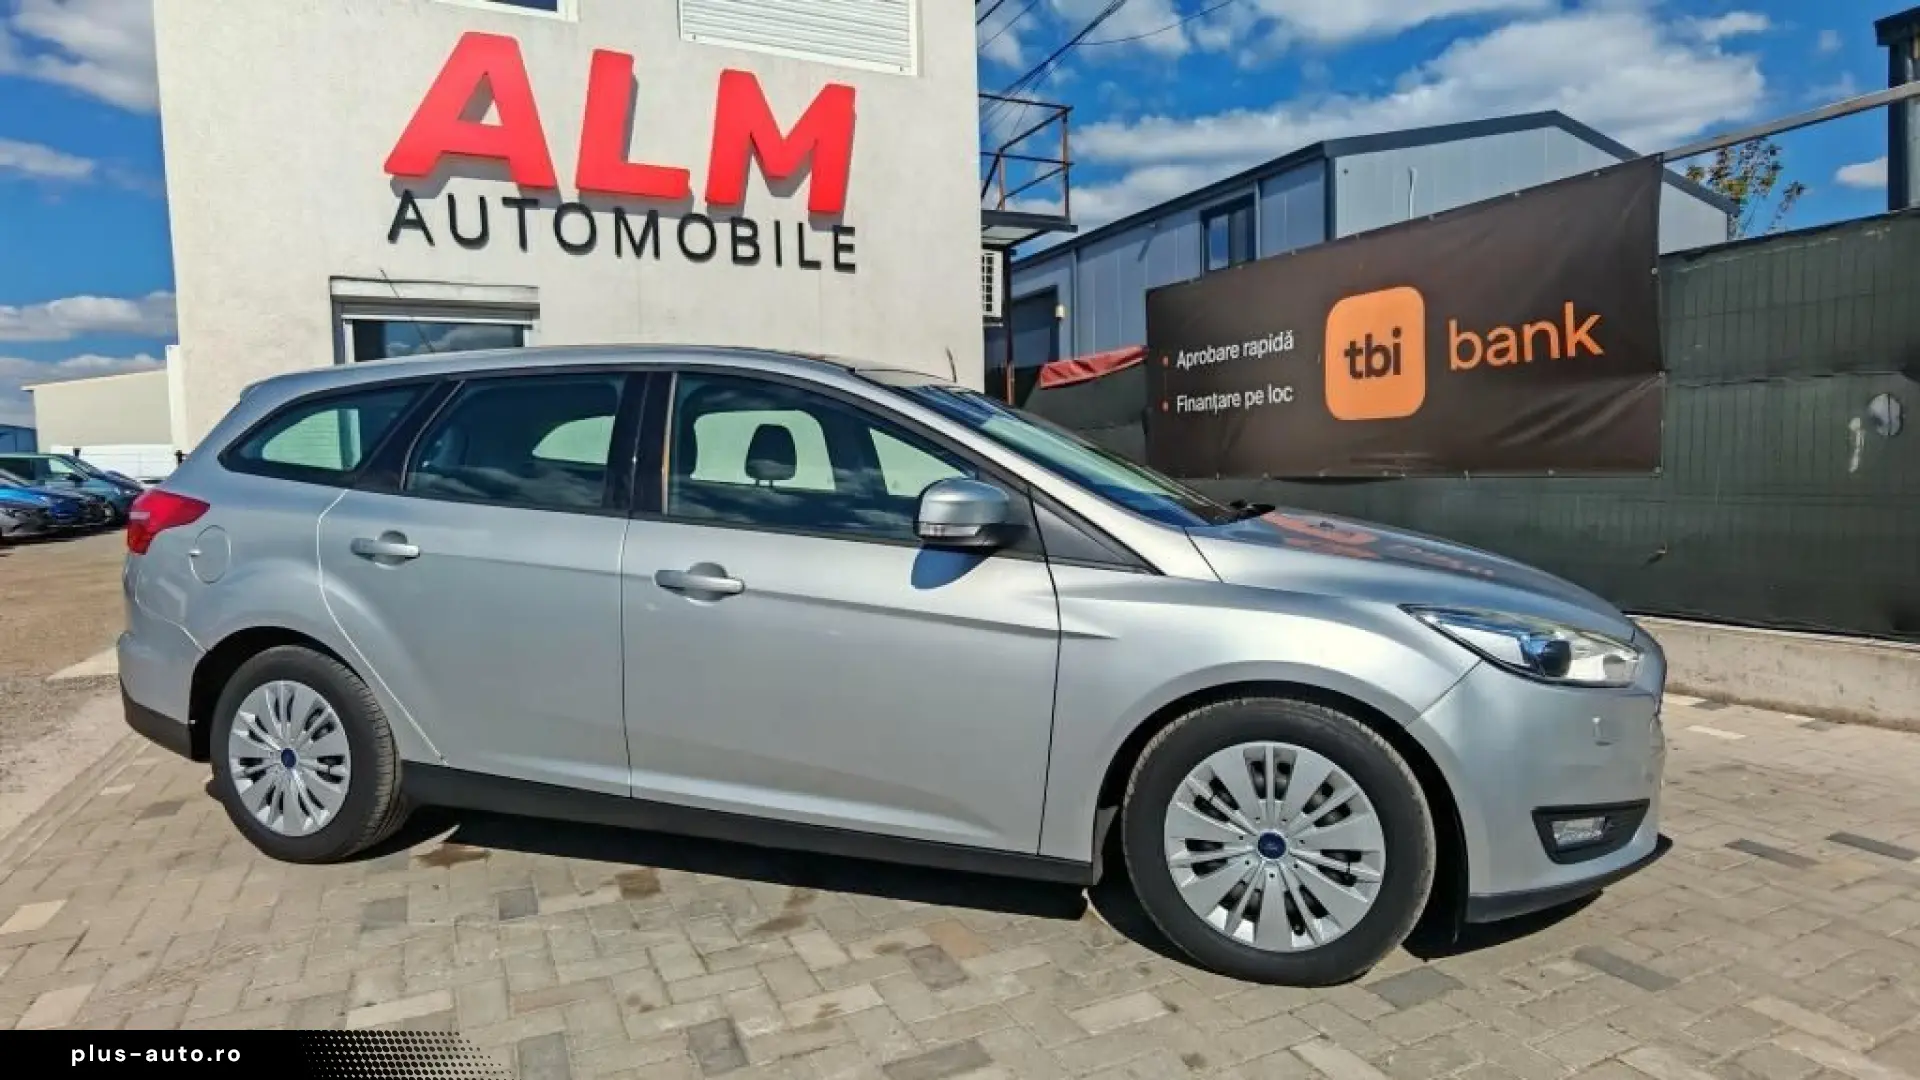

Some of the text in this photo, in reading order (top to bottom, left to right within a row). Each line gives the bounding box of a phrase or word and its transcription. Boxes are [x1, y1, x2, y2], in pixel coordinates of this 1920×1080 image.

[383, 31, 857, 214] ALM
[387, 189, 857, 273] AUTOMOBILE
[1176, 329, 1295, 371] Aprobare rapidă
[1344, 301, 1605, 380] tbi bank
[1244, 389, 1265, 410] pe
[1267, 383, 1294, 404] loc
